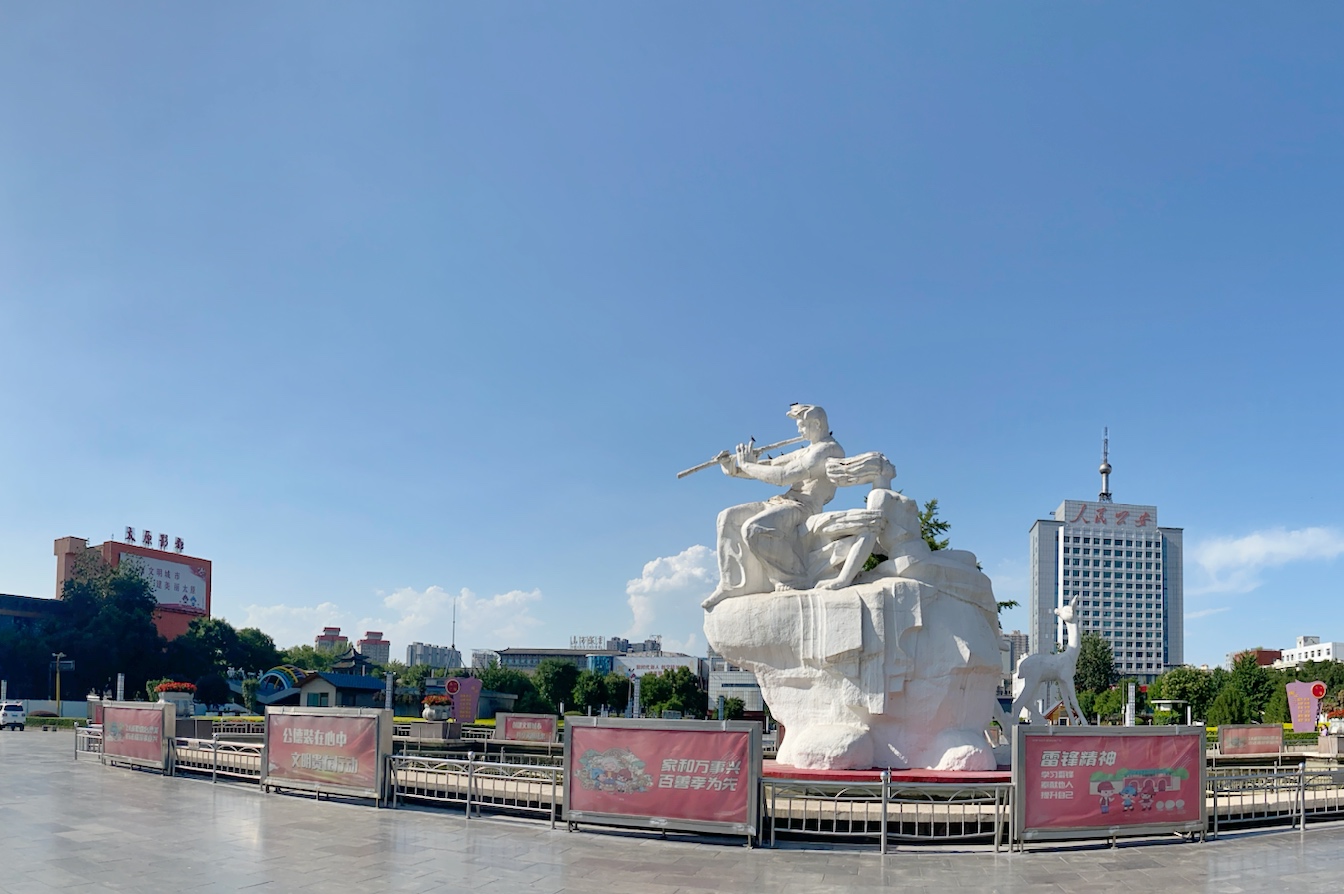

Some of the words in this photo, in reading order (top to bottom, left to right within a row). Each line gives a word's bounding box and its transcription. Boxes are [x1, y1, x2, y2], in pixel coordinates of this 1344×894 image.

[1070, 503, 1152, 527] 人民公安
[125, 526, 184, 550] 太原影都
[291, 752, 359, 774] 文明贵在行动
[660, 758, 741, 775] 家和万事兴
[1040, 750, 1117, 767] 雷锋精神
[658, 774, 739, 791] 百善孝为先
[1040, 770, 1074, 779] 学习雷锋
[1040, 791, 1074, 799] 提升自己
